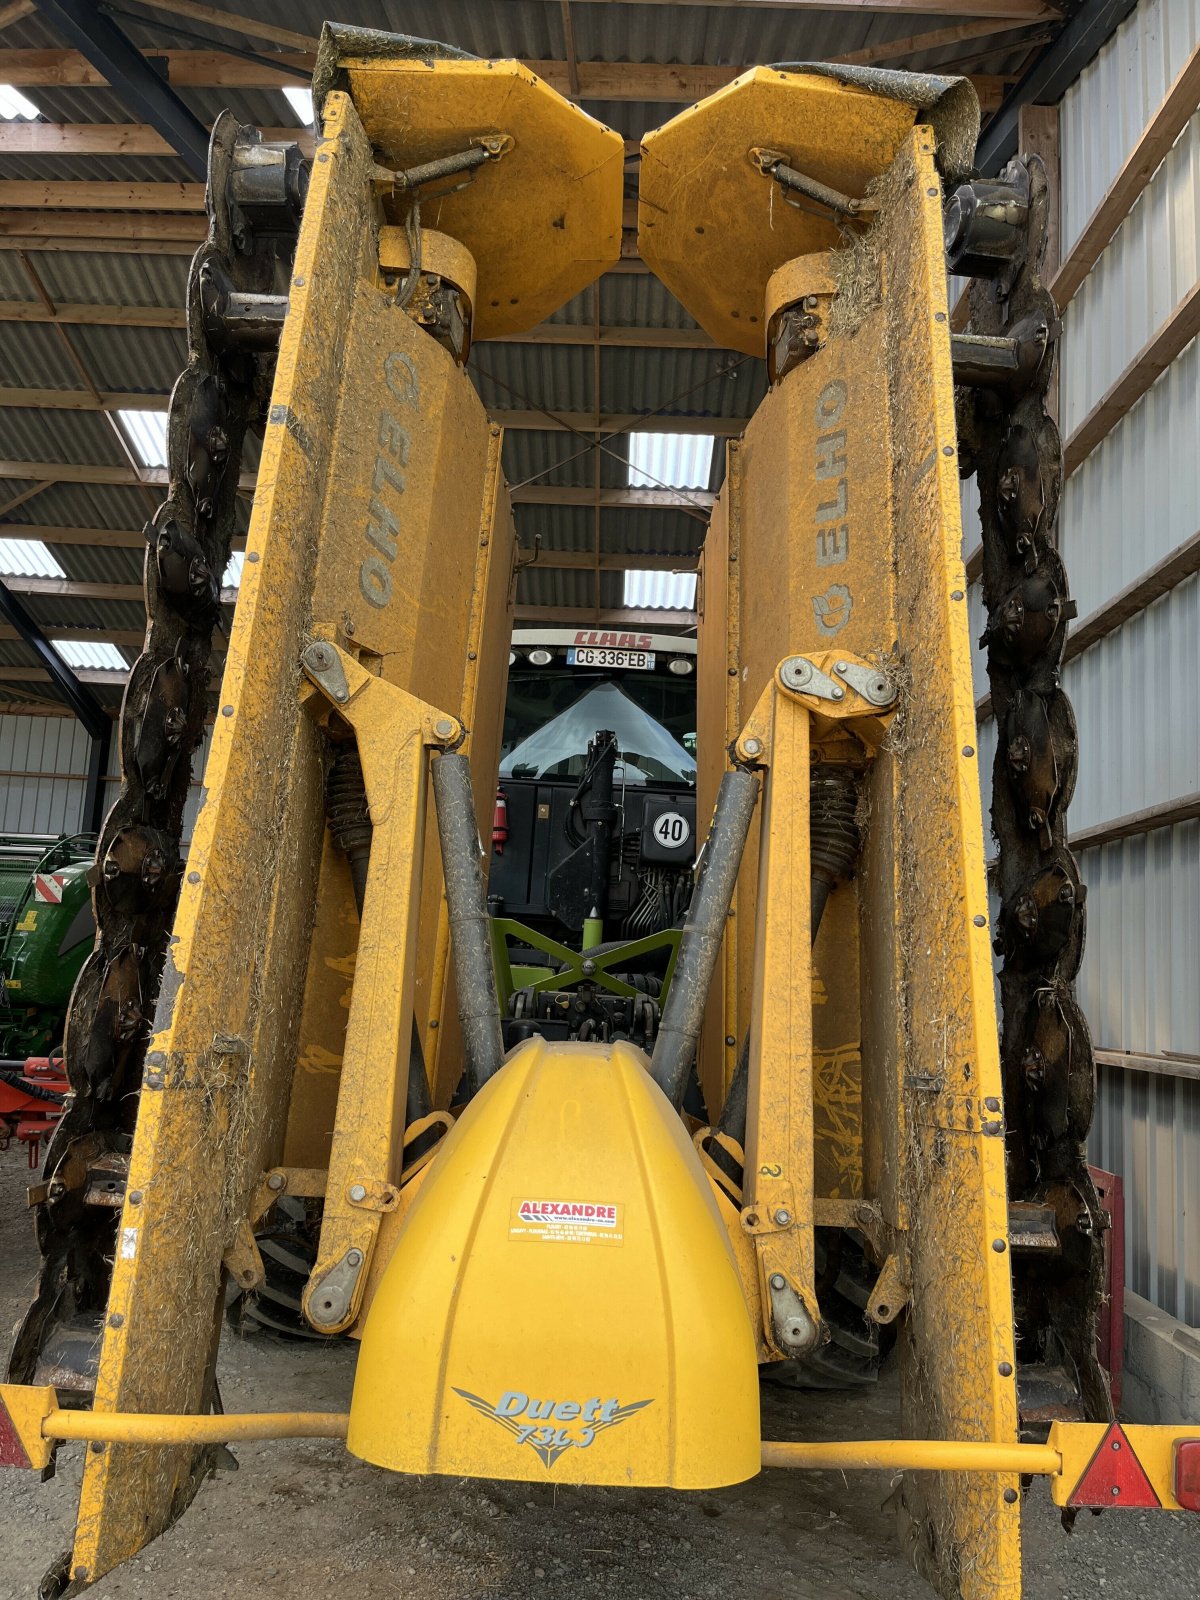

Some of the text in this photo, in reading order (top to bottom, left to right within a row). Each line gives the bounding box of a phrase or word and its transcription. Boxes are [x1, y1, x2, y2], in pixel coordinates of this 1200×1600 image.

[815, 379, 849, 567] ELHO
[360, 408, 411, 609] ELHO
[574, 631, 653, 648] CLAAS
[658, 818, 683, 841] 40
[520, 1202, 615, 1219] ALEXANDRE
[494, 1391, 620, 1424] Duett
